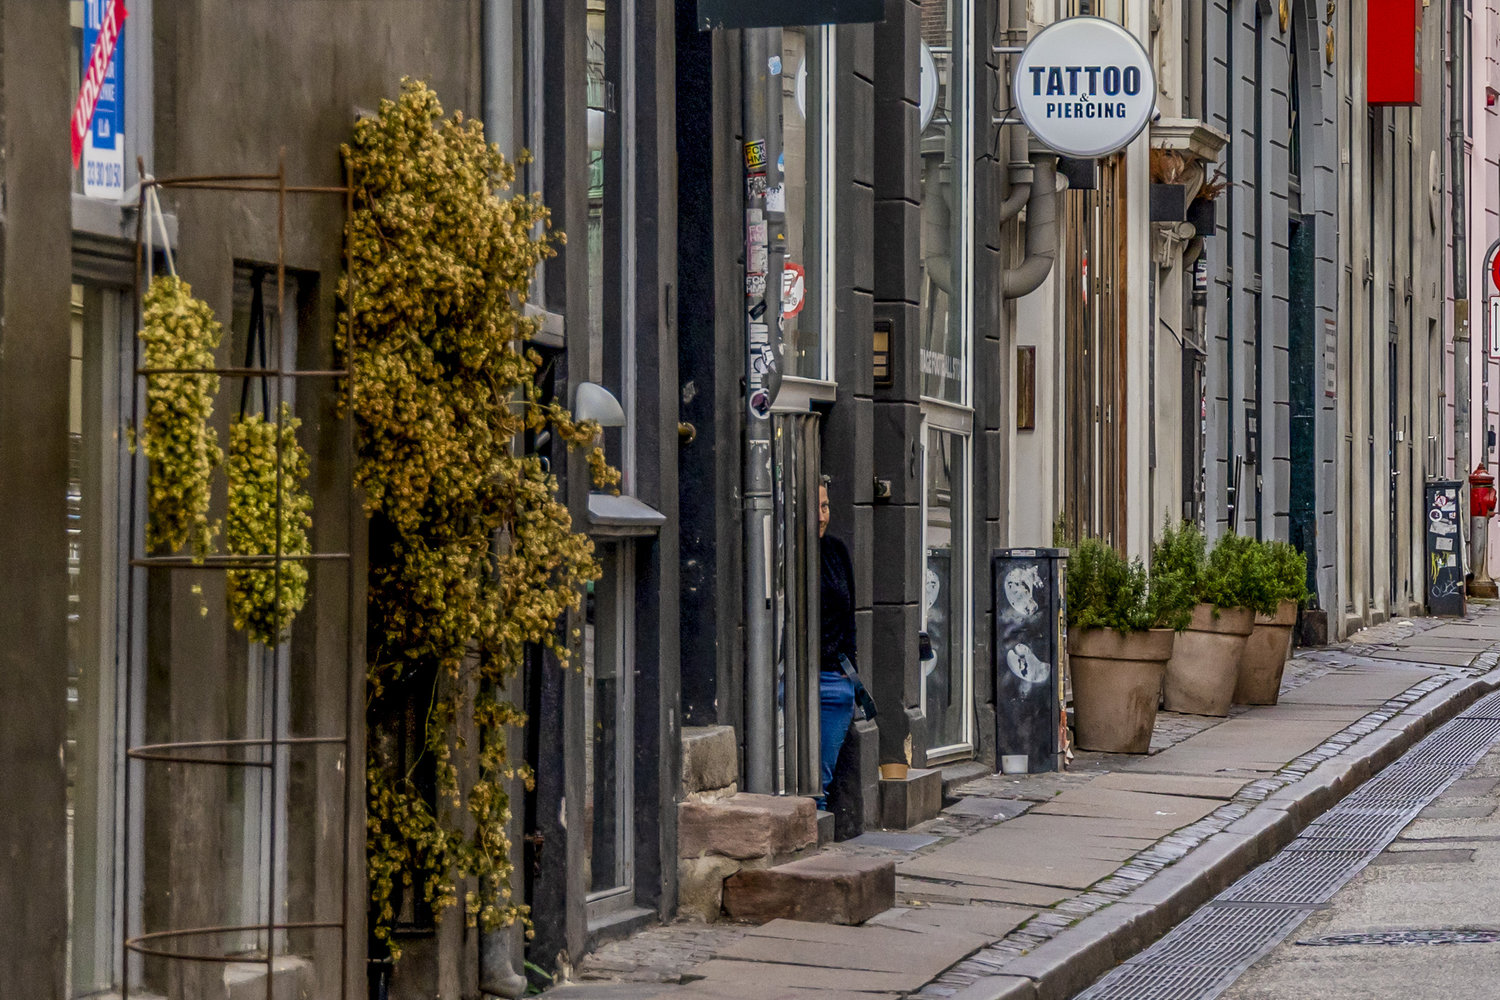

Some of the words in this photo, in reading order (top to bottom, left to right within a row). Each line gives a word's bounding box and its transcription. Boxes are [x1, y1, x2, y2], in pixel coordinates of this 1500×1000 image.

[1028, 66, 1141, 96] TATTOO
[1080, 93, 1089, 103] &
[1046, 103, 1126, 118] PIERCING
